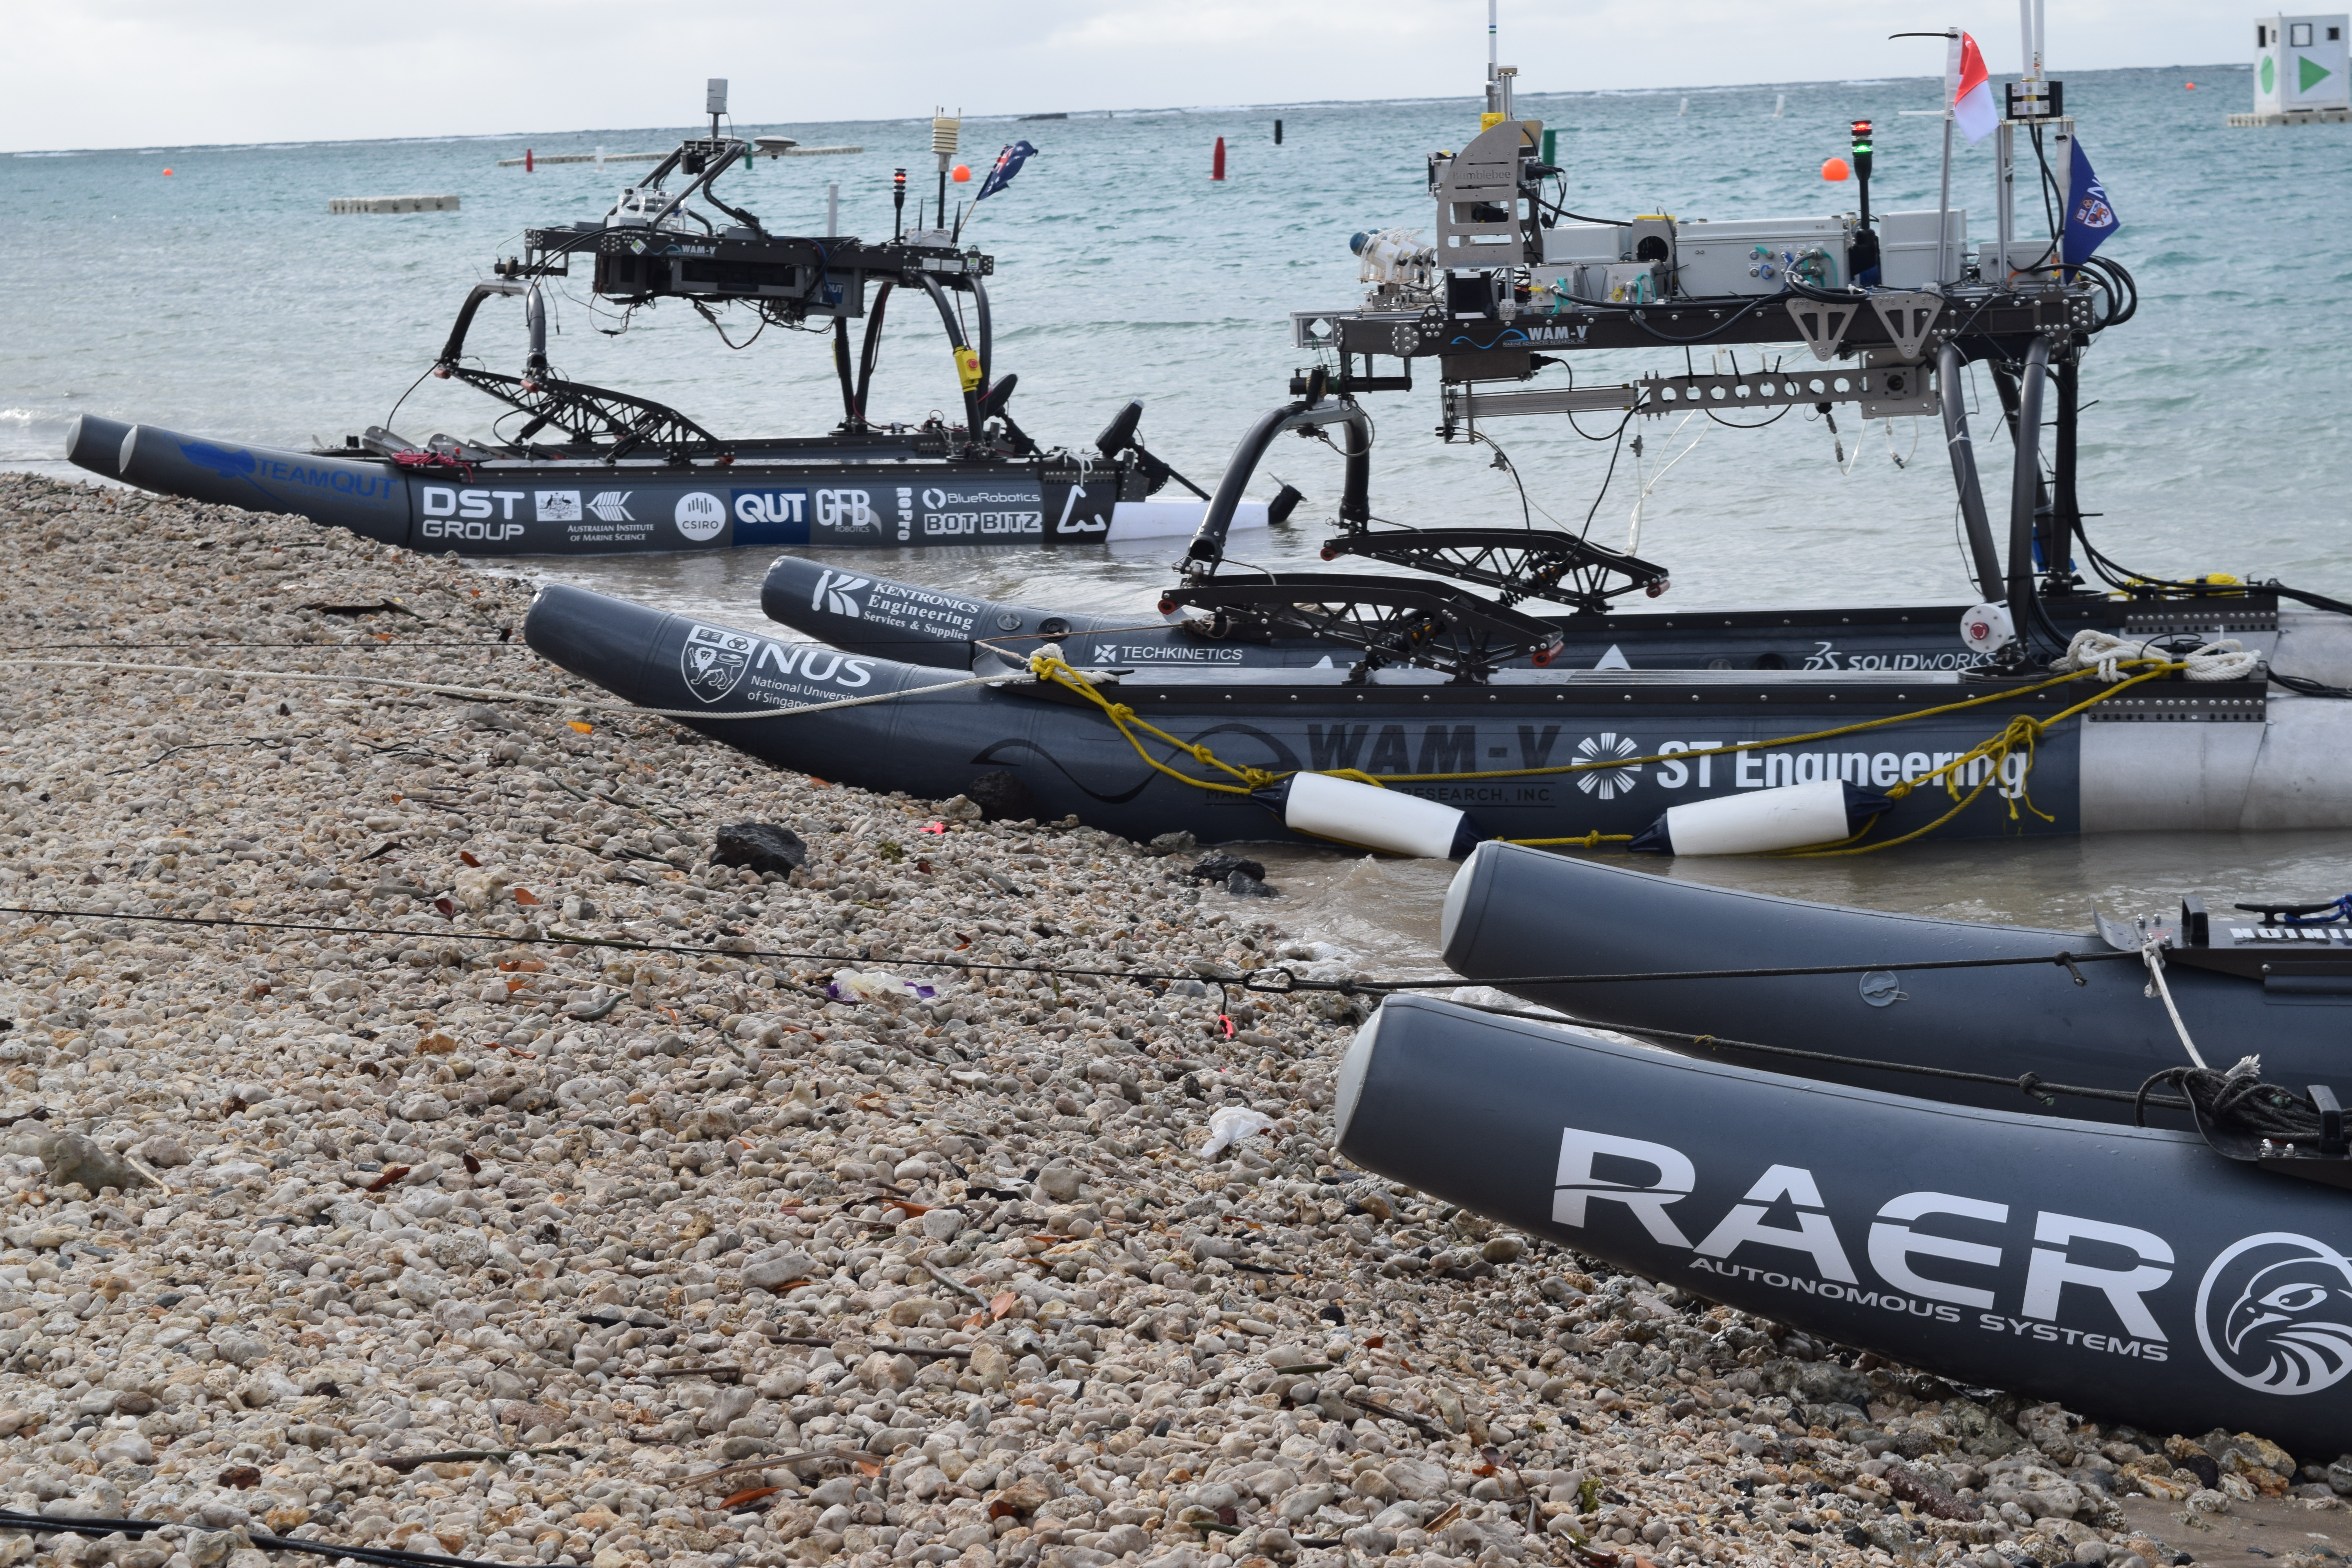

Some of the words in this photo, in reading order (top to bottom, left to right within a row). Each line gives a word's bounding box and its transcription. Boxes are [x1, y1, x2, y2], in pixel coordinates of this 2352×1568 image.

[1453, 170, 1510, 180] Bumblebee
[682, 245, 716, 254] WAM-V
[1528, 325, 1588, 340] WAM-V
[258, 458, 397, 500] TEAMQUT
[423, 486, 525, 519] DST
[735, 494, 806, 523] QUT
[816, 489, 871, 526] GFB
[947, 492, 1041, 504] BlueRobotics
[423, 520, 524, 541] GROUP
[682, 521, 719, 529] CSIRO
[924, 513, 978, 535] BOT
[980, 512, 1042, 533] BITZ
[873, 583, 980, 613] KENTRONICS
[864, 611, 906, 628] Services
[910, 621, 919, 630] &
[924, 623, 968, 640] Supplies
[867, 595, 974, 630] Engineering
[756, 642, 876, 687] NUS
[1122, 646, 1243, 660] TECHKINETICS
[1847, 652, 1996, 671] SOLIDWORKS
[748, 691, 762, 701] of
[751, 675, 801, 693] National
[804, 686, 857, 701] Universit
[1307, 724, 1561, 774] WAM-V
[1657, 741, 1722, 788] ST
[1735, 741, 2027, 799] Engineering
[1517, 788, 1553, 801] INC.
[1552, 1127, 2174, 1343] RAER
[1688, 1257, 1960, 1323] AUTONOMOUS
[1979, 1313, 2169, 1361] SYSTEMS
